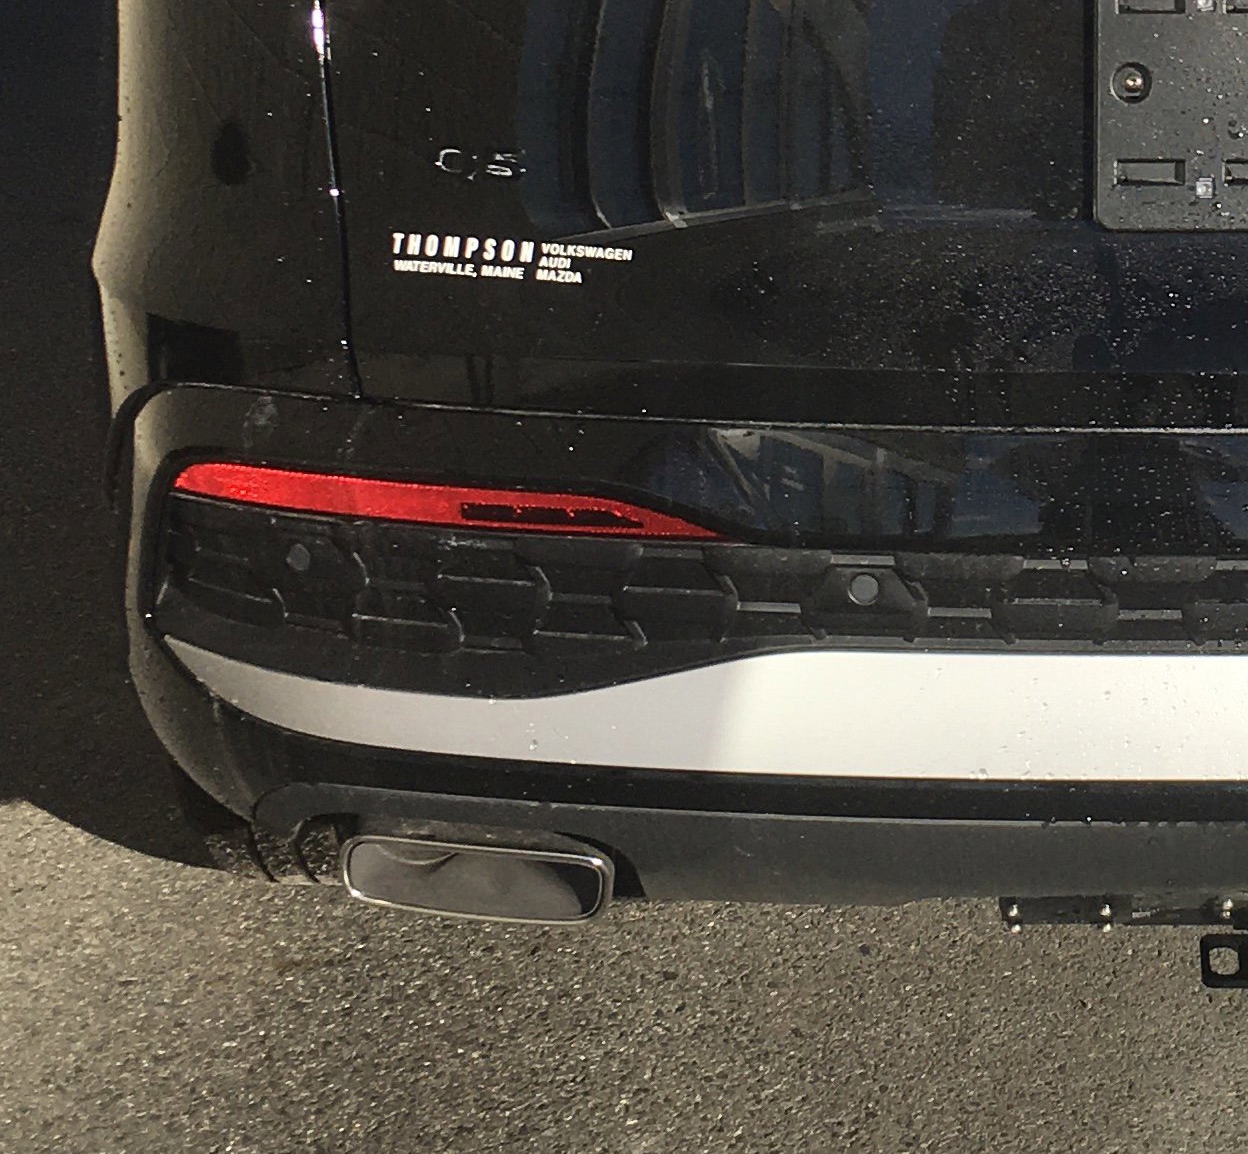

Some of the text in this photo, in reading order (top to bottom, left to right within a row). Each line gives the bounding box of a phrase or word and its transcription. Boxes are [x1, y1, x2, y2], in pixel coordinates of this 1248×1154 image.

[392, 232, 535, 263] THOMPSON
[541, 242, 633, 261] VOLKSWAGEN
[393, 259, 525, 280] WATERVILLE, MAINE
[538, 256, 571, 269] AUDI
[535, 268, 583, 283] MAZDA
